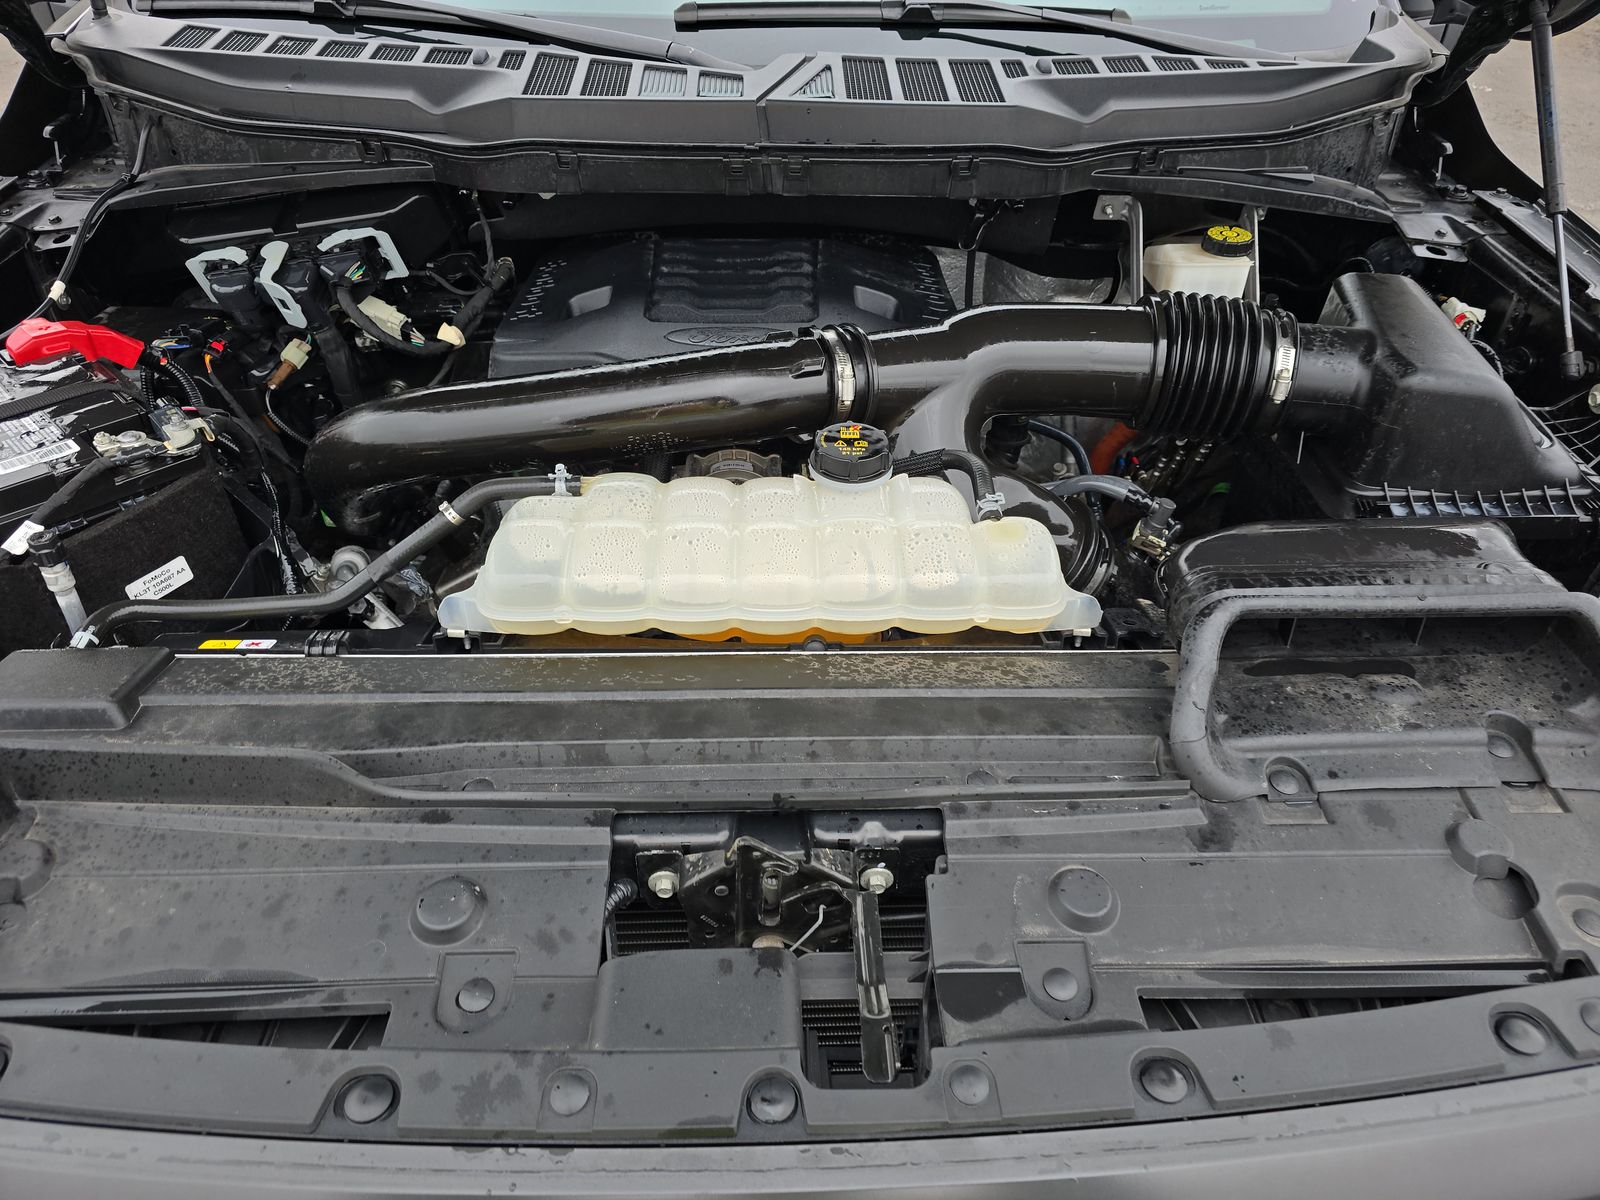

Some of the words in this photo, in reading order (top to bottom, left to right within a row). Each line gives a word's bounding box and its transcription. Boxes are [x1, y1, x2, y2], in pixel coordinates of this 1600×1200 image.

[134, 586, 151, 599] KL3T
[176, 567, 186, 576] AA
[143, 568, 171, 586] FoMoCo
[153, 583, 174, 596] C500L
